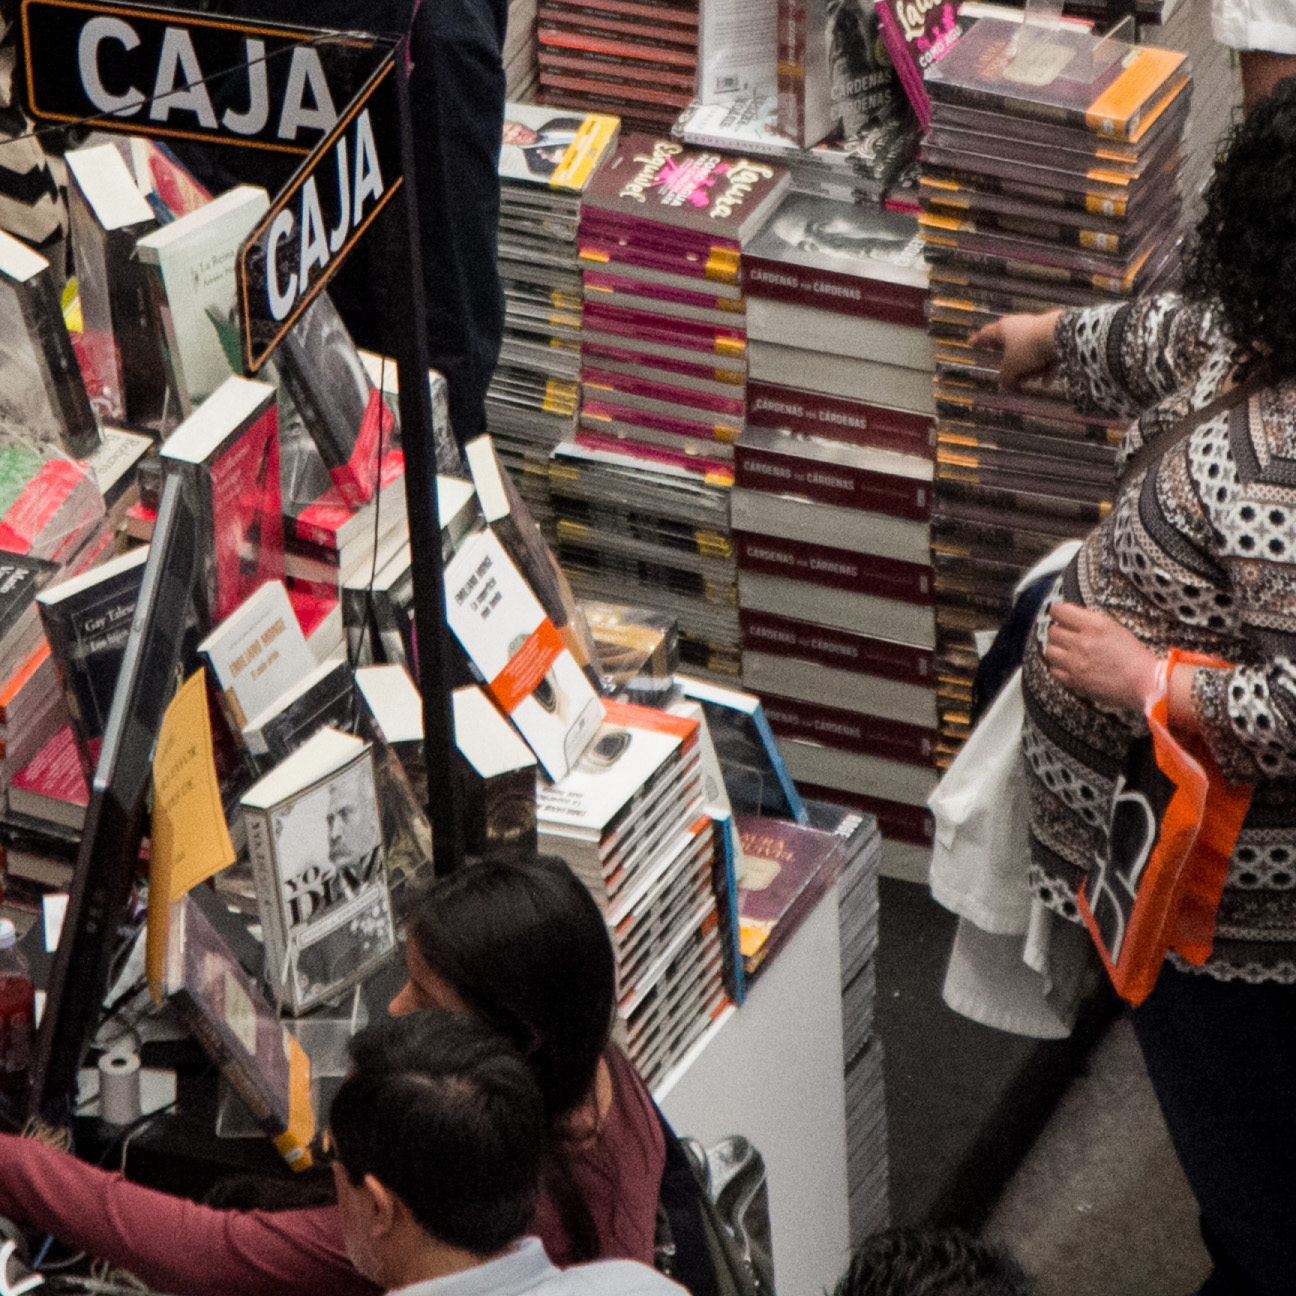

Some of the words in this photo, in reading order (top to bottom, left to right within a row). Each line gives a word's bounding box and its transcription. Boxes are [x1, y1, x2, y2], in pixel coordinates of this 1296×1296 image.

[918, 42, 945, 68] COMO
[78, 16, 339, 140] CAJA
[829, 69, 892, 101] CÁRDENAS
[619, 139, 683, 204] Esquivel
[710, 159, 774, 219] Laura
[266, 107, 384, 321] CAJA
[750, 269, 799, 290] CÁRDENAS
[813, 282, 862, 302] CÁRDENAS
[755, 397, 804, 418] CÁRDENAS
[818, 410, 867, 430] CÁRDENAS
[743, 460, 792, 480] CÁRDENAS
[806, 473, 855, 493] CÁRDENAS
